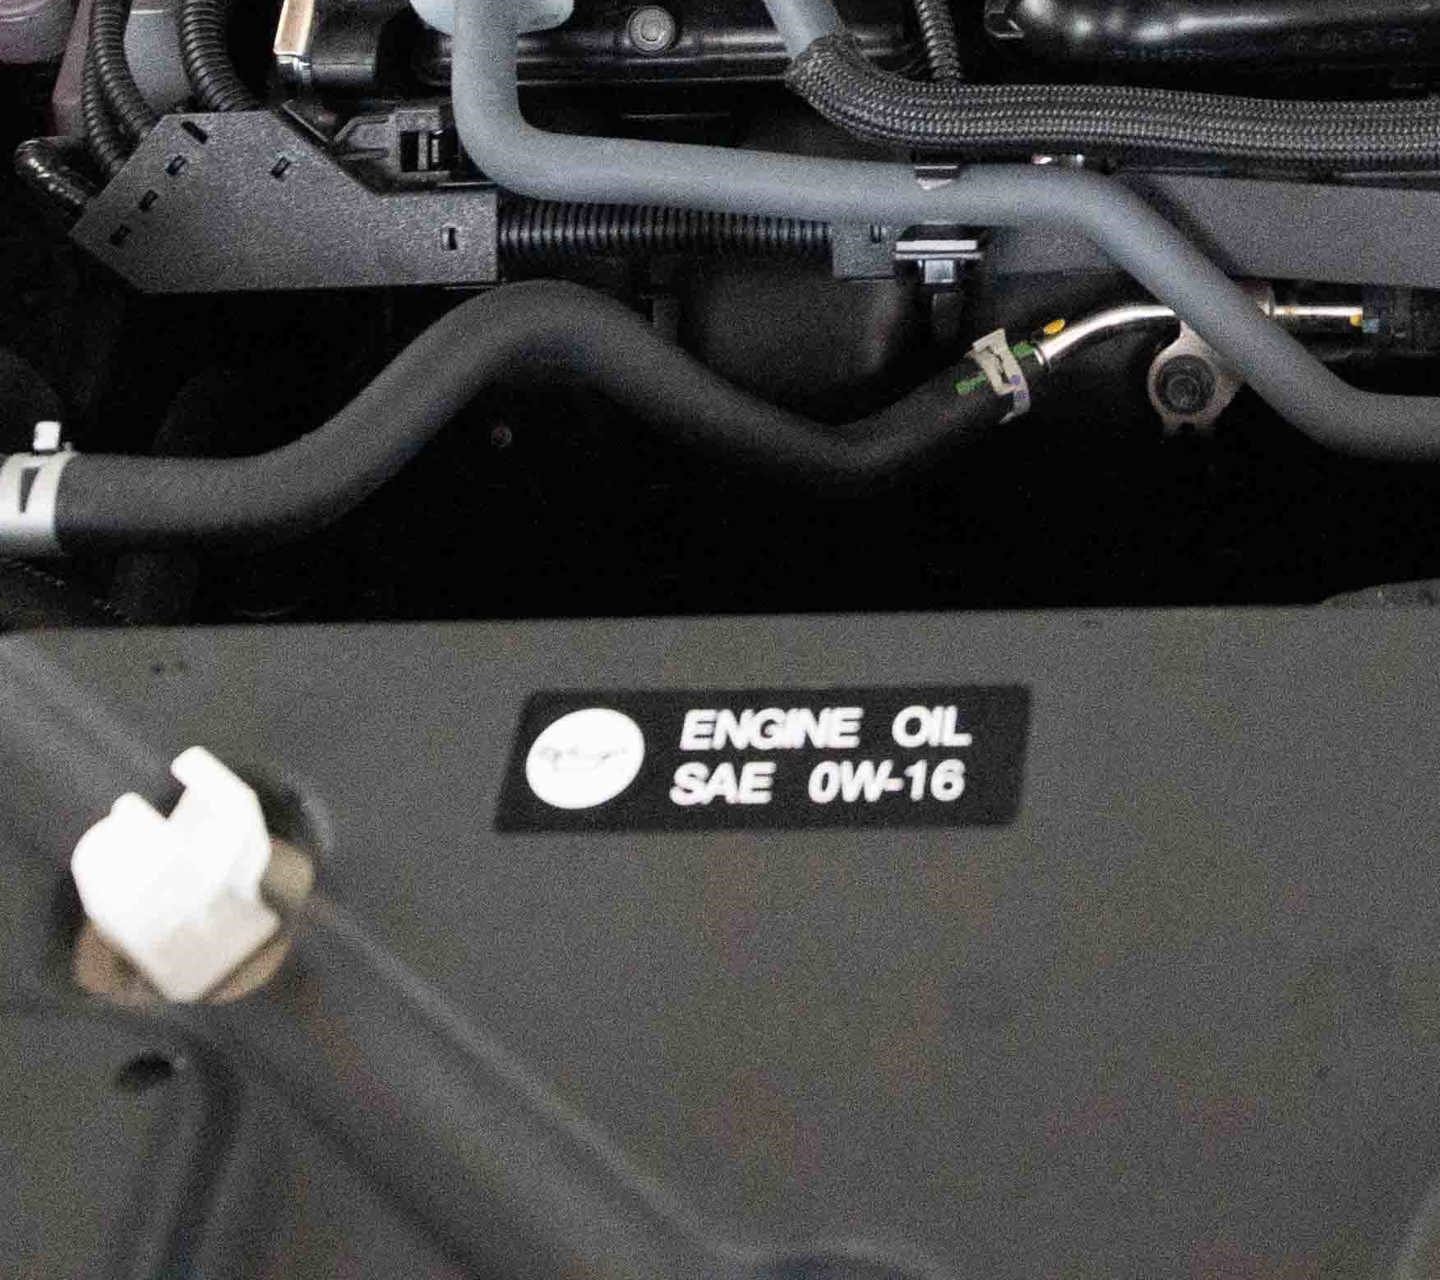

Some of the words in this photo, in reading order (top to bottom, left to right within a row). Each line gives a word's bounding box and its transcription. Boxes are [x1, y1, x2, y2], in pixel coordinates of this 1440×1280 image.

[679, 706, 864, 751] ENGINE
[891, 705, 973, 748] OIL
[669, 761, 777, 806] SAE
[808, 758, 967, 804] 0W-16
